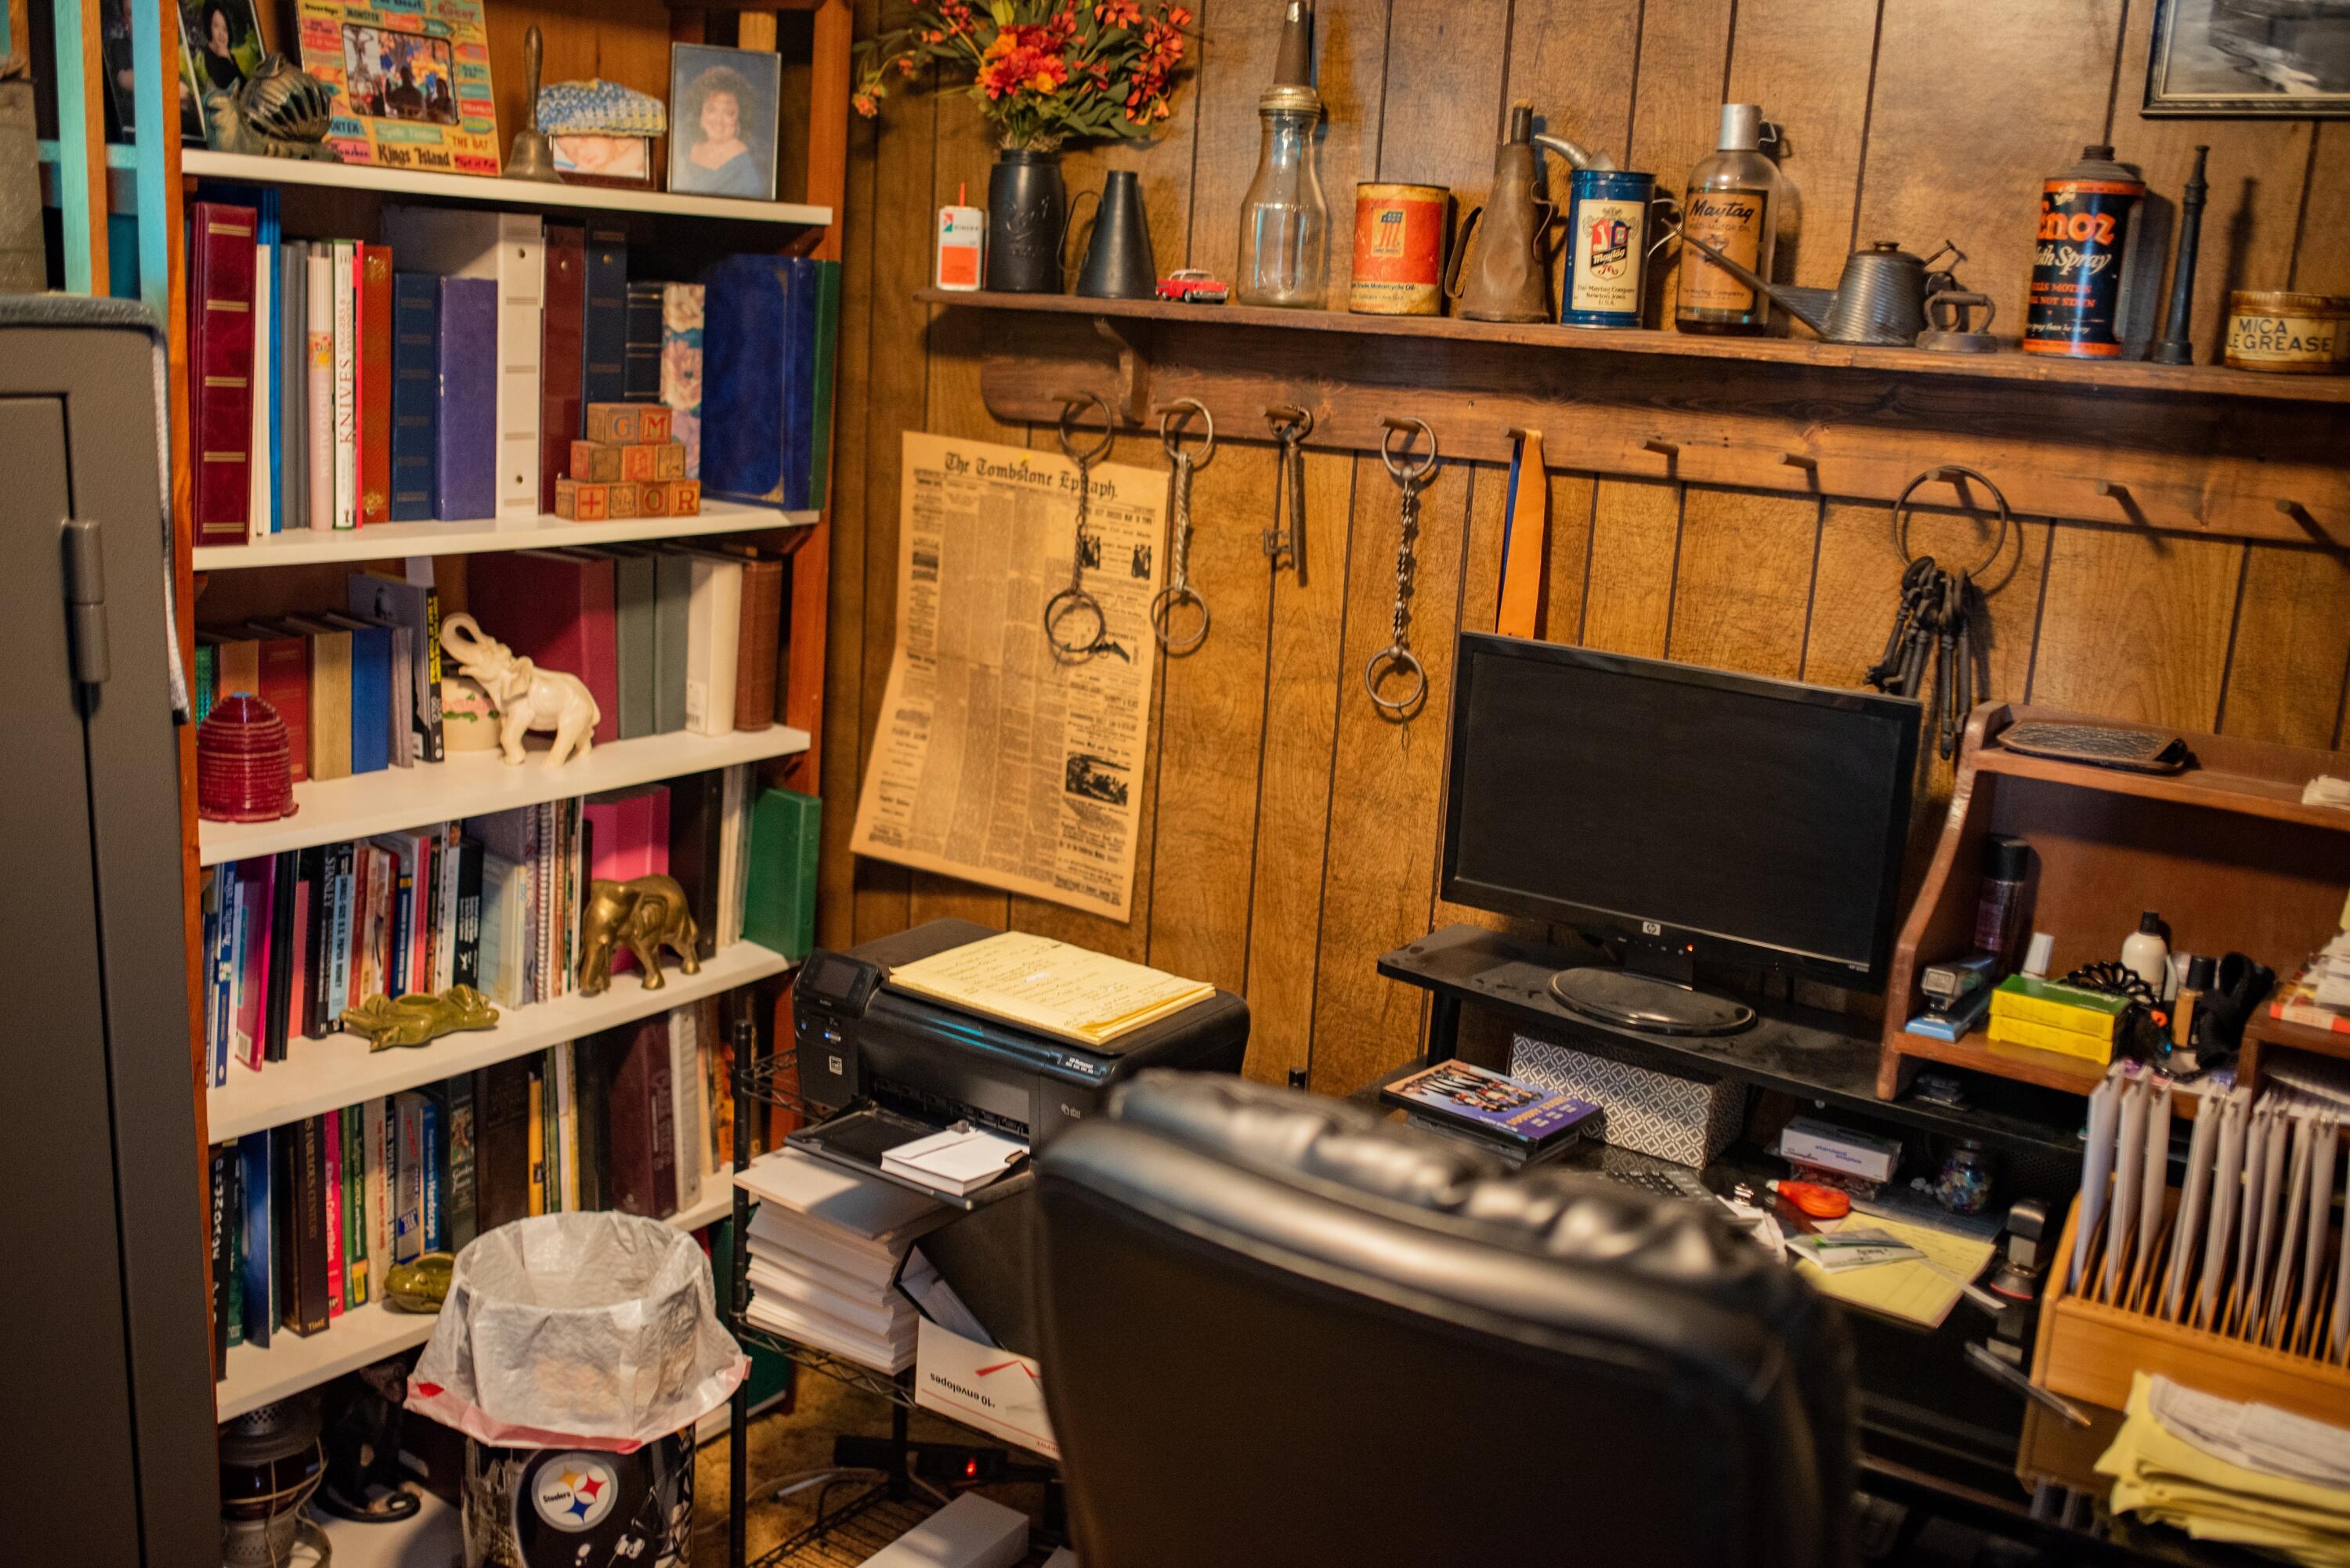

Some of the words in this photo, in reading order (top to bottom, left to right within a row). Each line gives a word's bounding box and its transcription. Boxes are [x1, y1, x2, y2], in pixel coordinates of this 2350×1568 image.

[378, 144, 410, 166] Kings
[414, 148, 452, 167] Island
[1690, 198, 1755, 224] Maytag
[1593, 248, 1625, 265] Maytag
[2055, 245, 2113, 276] Spray
[2239, 318, 2287, 335] MICA
[2243, 334, 2333, 353] GREASE
[339, 359, 352, 444] KNIVES
[646, 416, 666, 439] M
[944, 451, 970, 476] The
[976, 457, 1053, 486] Tombstone
[1058, 471, 1119, 500] Epaph.
[645, 489, 663, 511] O
[678, 490, 696, 510] R
[525, 807, 533, 842] NIVES
[324, 857, 337, 908] STANLEY
[1815, 1144, 1848, 1157] standard
[1835, 1154, 1862, 1165] staples
[425, 1180, 437, 1240] Hardscape
[308, 1318, 326, 1331] TIME
[930, 1372, 980, 1400] envelopes
[542, 1490, 571, 1504] Steelers
